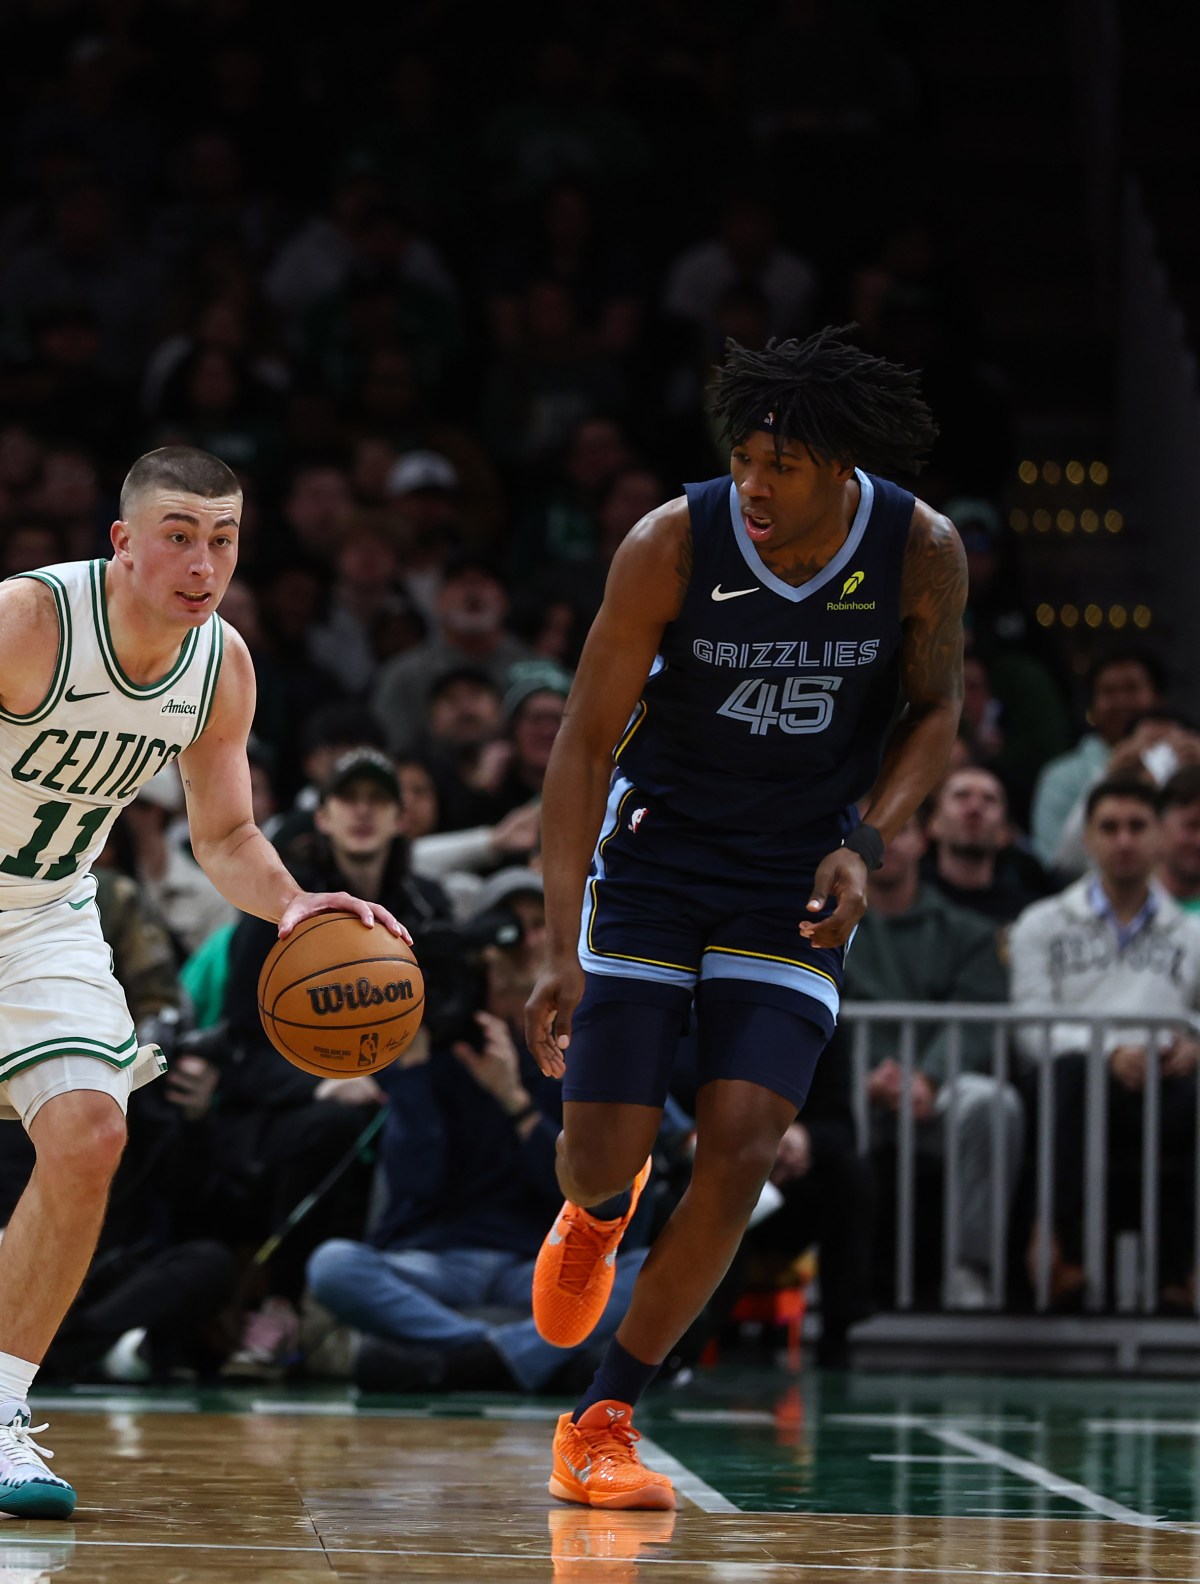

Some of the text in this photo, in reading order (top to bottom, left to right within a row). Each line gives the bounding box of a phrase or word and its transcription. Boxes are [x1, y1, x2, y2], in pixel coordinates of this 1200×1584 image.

[826, 601, 876, 611] Robinhood
[692, 638, 881, 669] GRIZZLIES
[161, 699, 197, 715] Amica
[716, 675, 844, 736] 45
[306, 977, 414, 1016] Wilson
